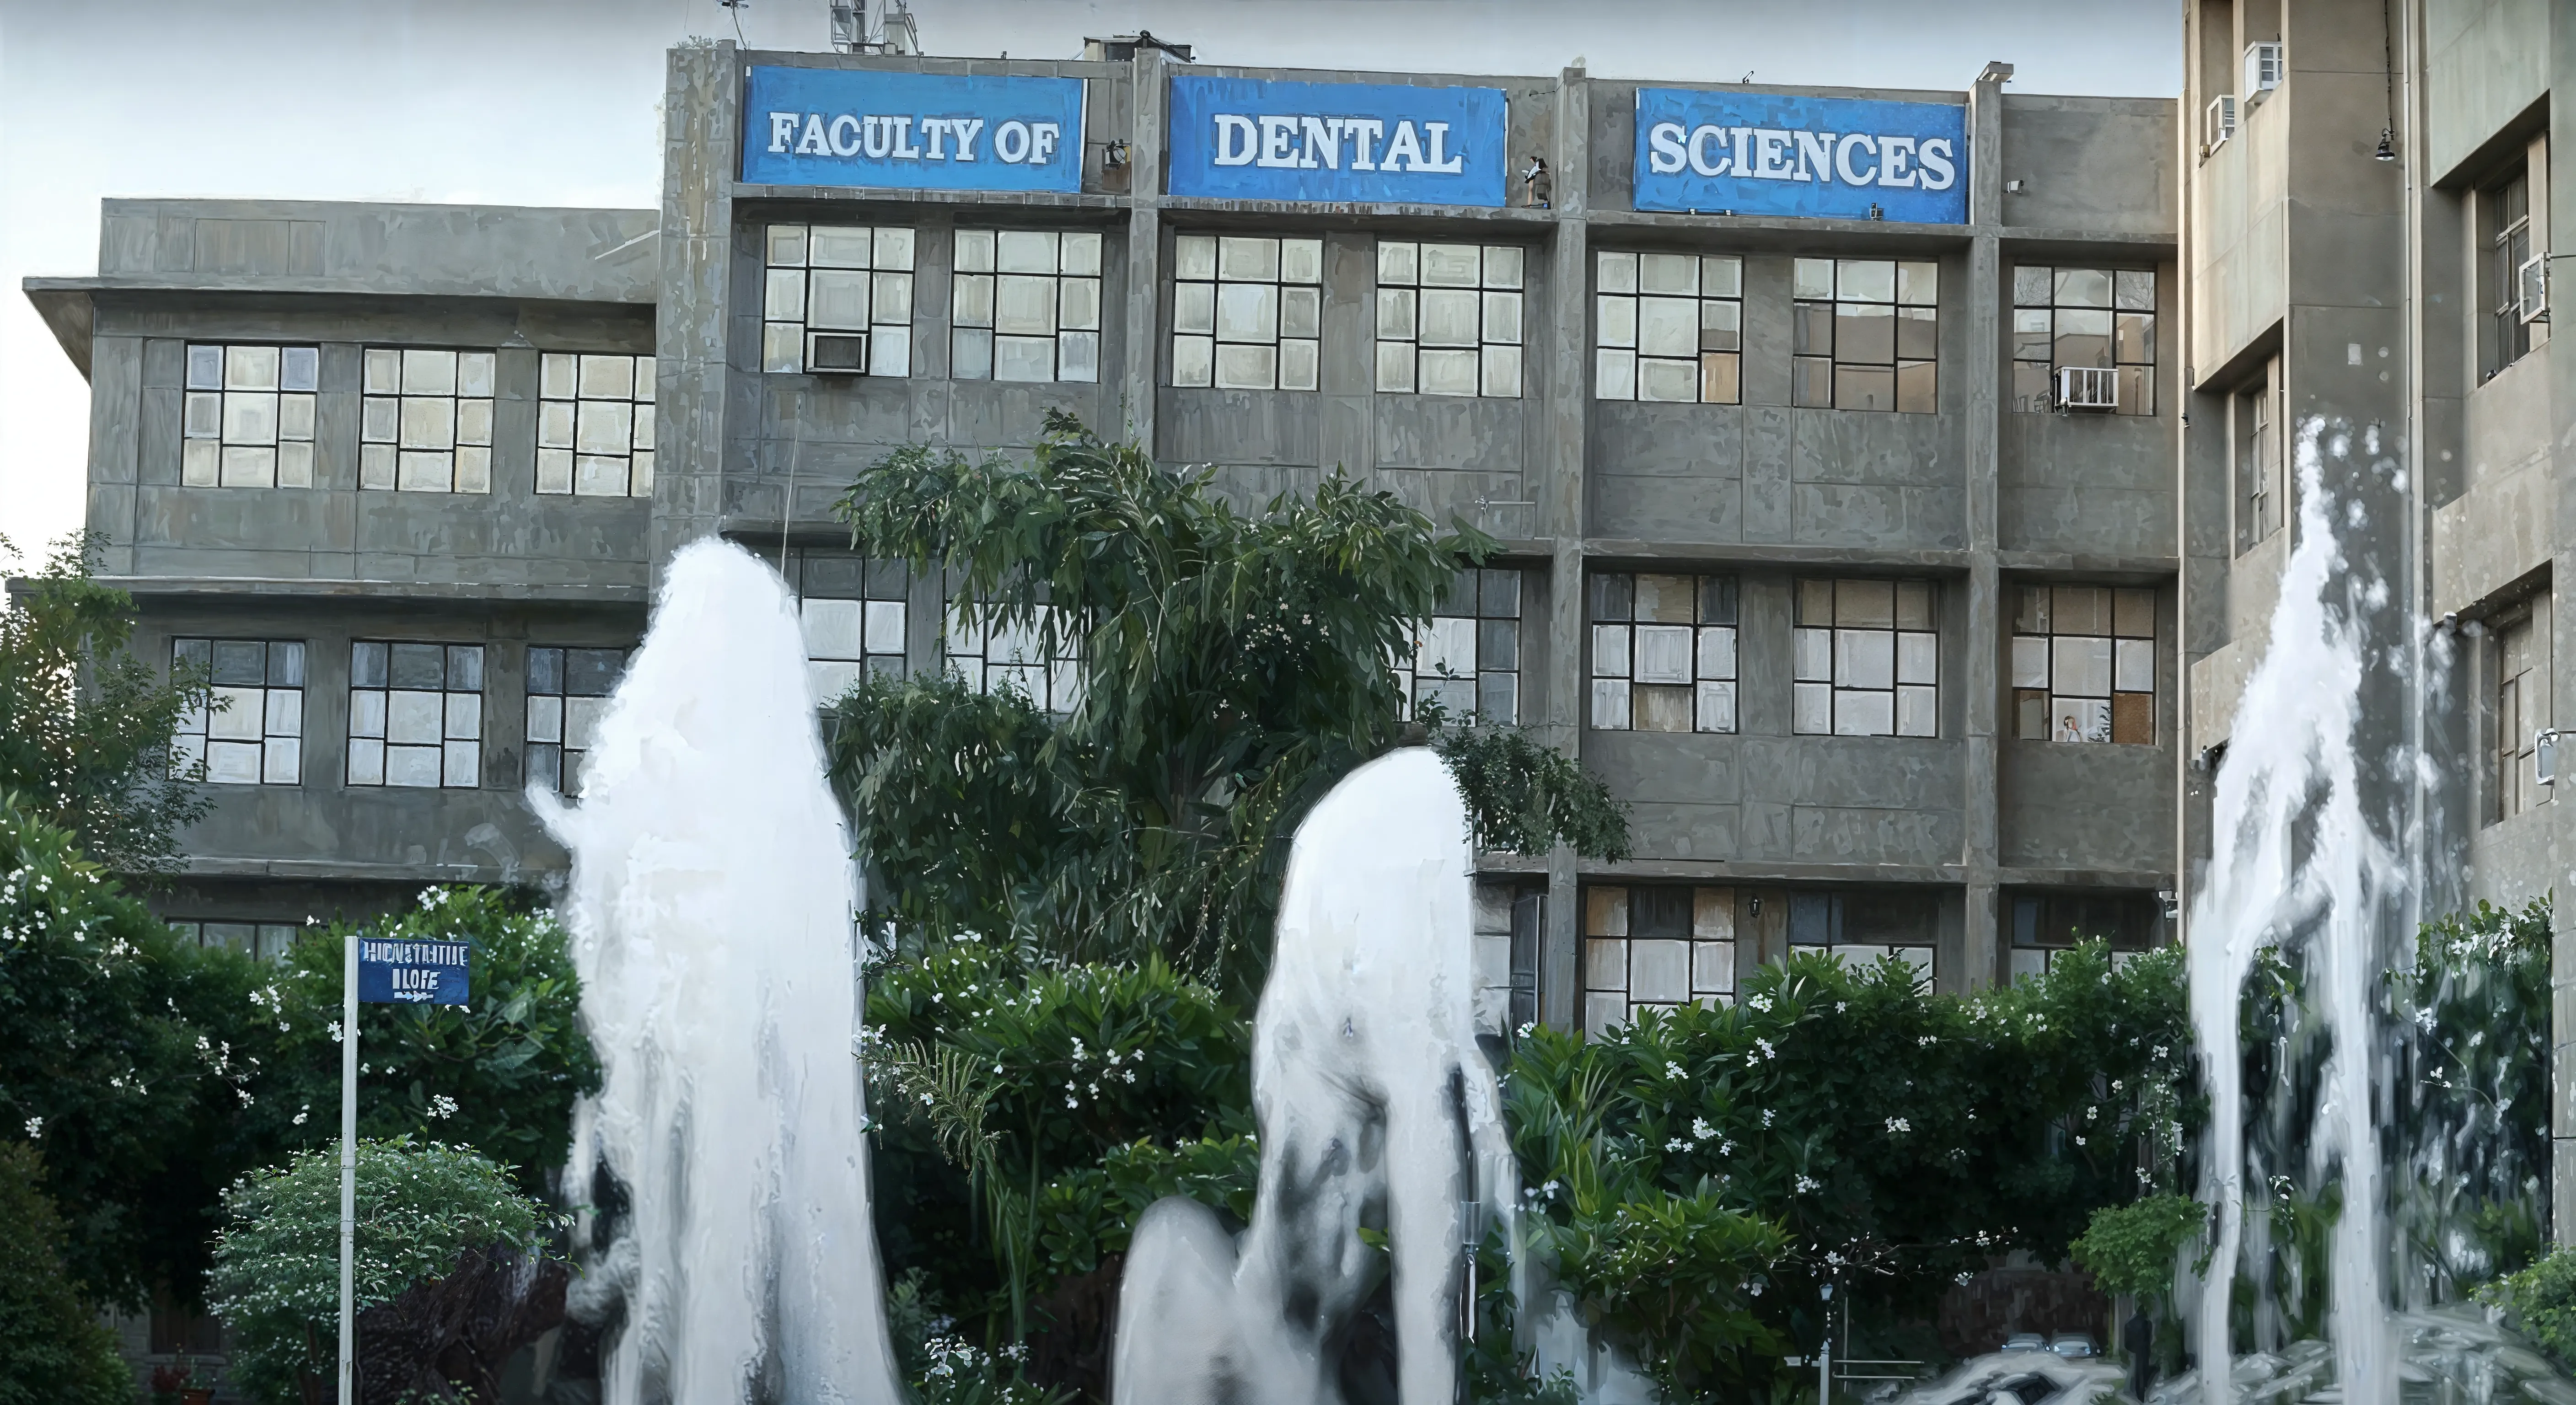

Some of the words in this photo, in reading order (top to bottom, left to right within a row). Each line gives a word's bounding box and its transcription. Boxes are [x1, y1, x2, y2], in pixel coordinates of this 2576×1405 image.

[767, 112, 983, 161] FACULTY
[995, 121, 1059, 164] OF
[1214, 114, 1462, 173] DENTAL
[1650, 122, 1955, 190] SCIENCES
